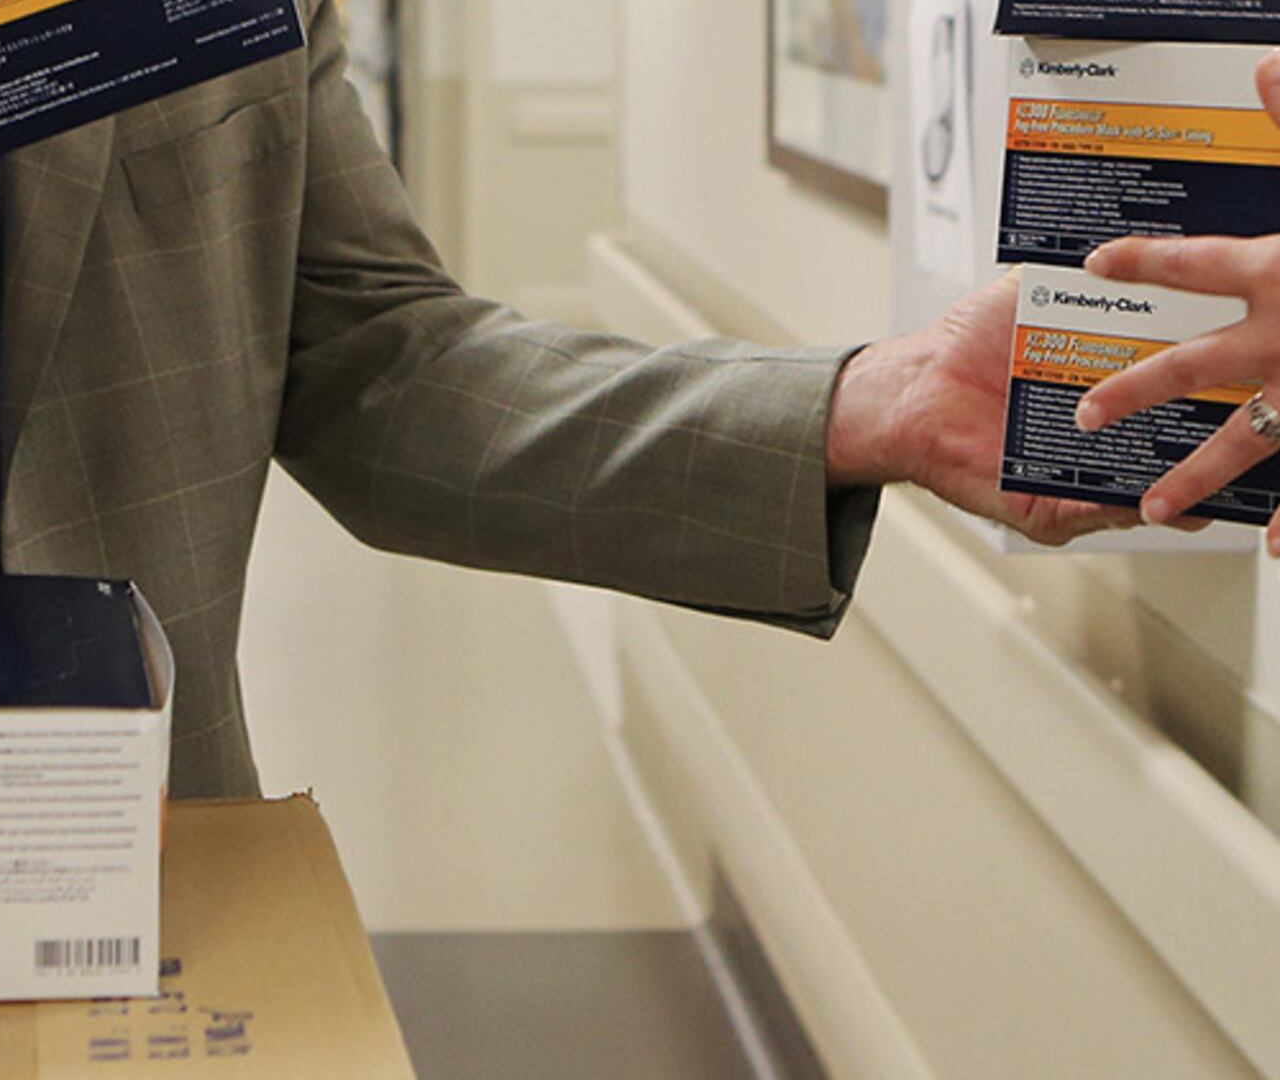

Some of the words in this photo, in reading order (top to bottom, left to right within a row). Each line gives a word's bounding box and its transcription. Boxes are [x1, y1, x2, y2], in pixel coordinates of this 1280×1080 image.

[1038, 62, 1115, 78] Kimberly-Clark
[1053, 291, 1153, 314] Kimberly-Clark
[1026, 332, 1066, 349] KC300
